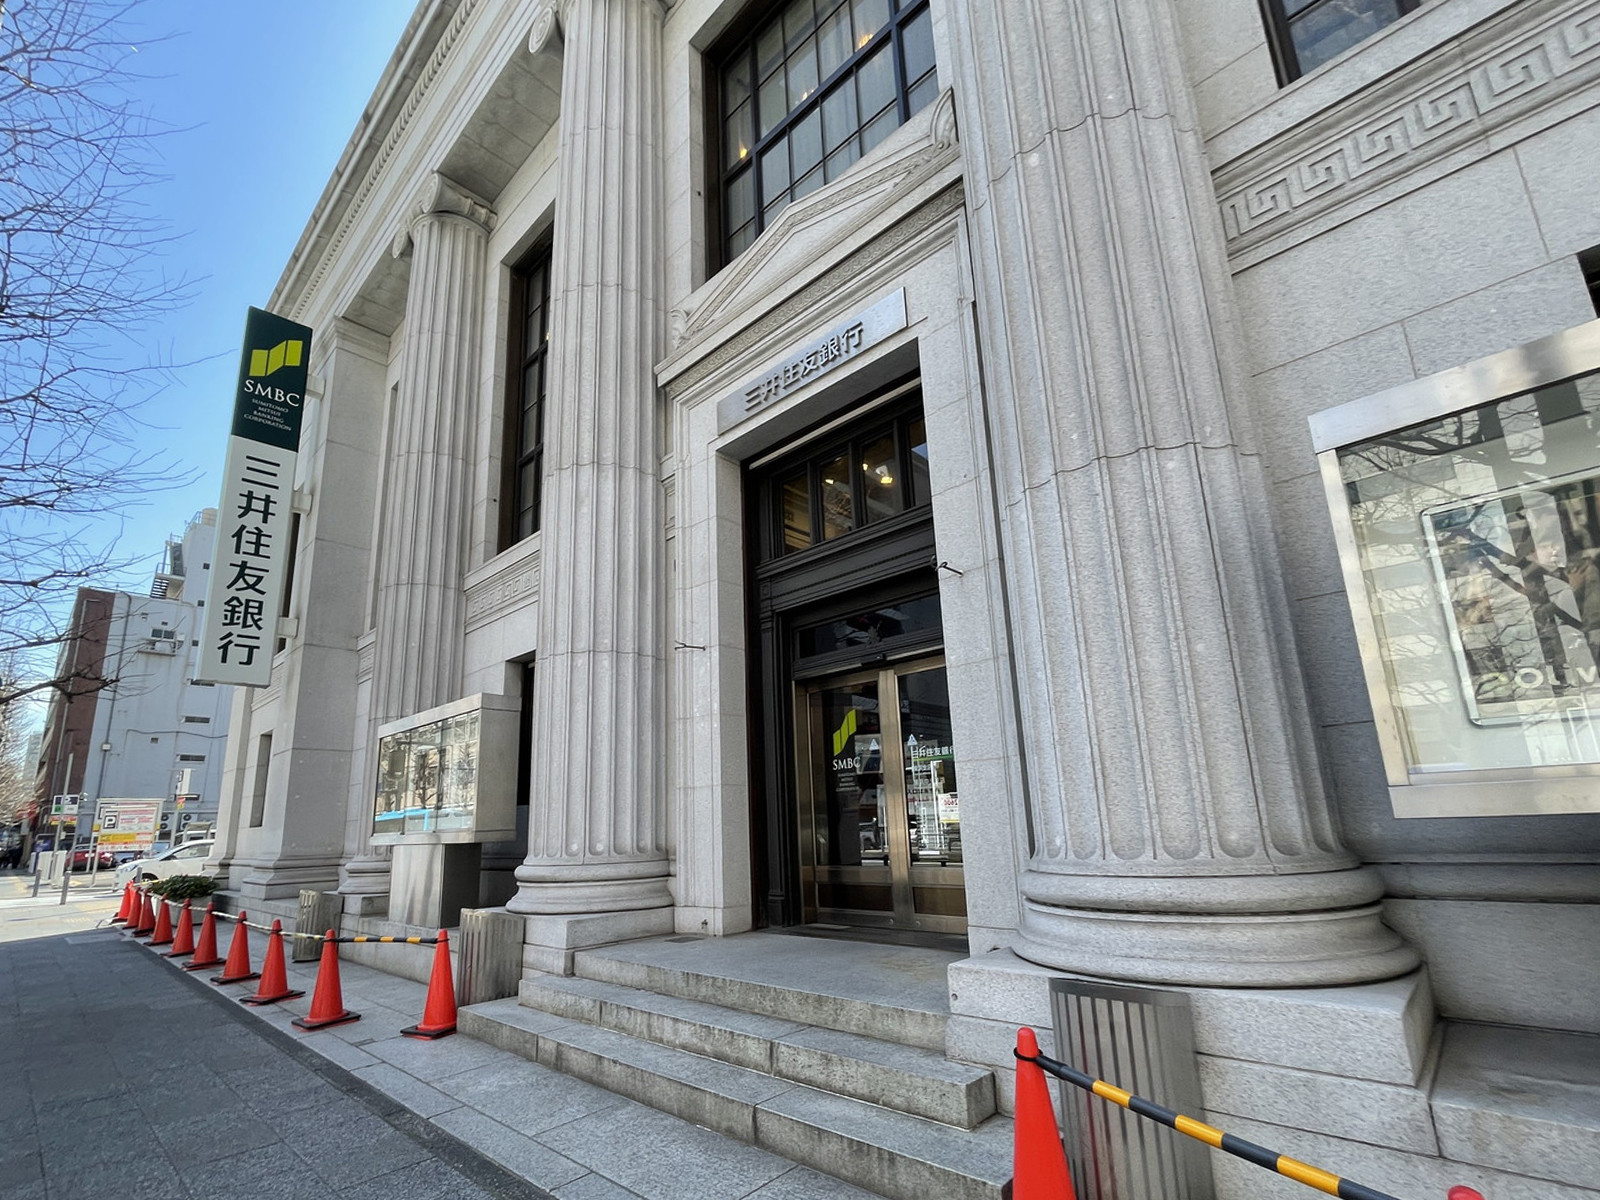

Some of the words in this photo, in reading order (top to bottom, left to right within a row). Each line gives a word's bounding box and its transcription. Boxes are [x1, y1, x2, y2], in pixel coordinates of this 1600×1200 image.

[744, 320, 863, 411] 三井住友銀行
[244, 379, 300, 407] SMBC
[252, 398, 289, 413] SUMITOMO
[258, 406, 282, 417] MITSUI
[244, 413, 292, 431] CORPORATION
[253, 410, 284, 423] BANKING
[217, 455, 281, 665] 三井住友銀行
[832, 756, 861, 771] SMBC
[104, 816, 116, 828] P
